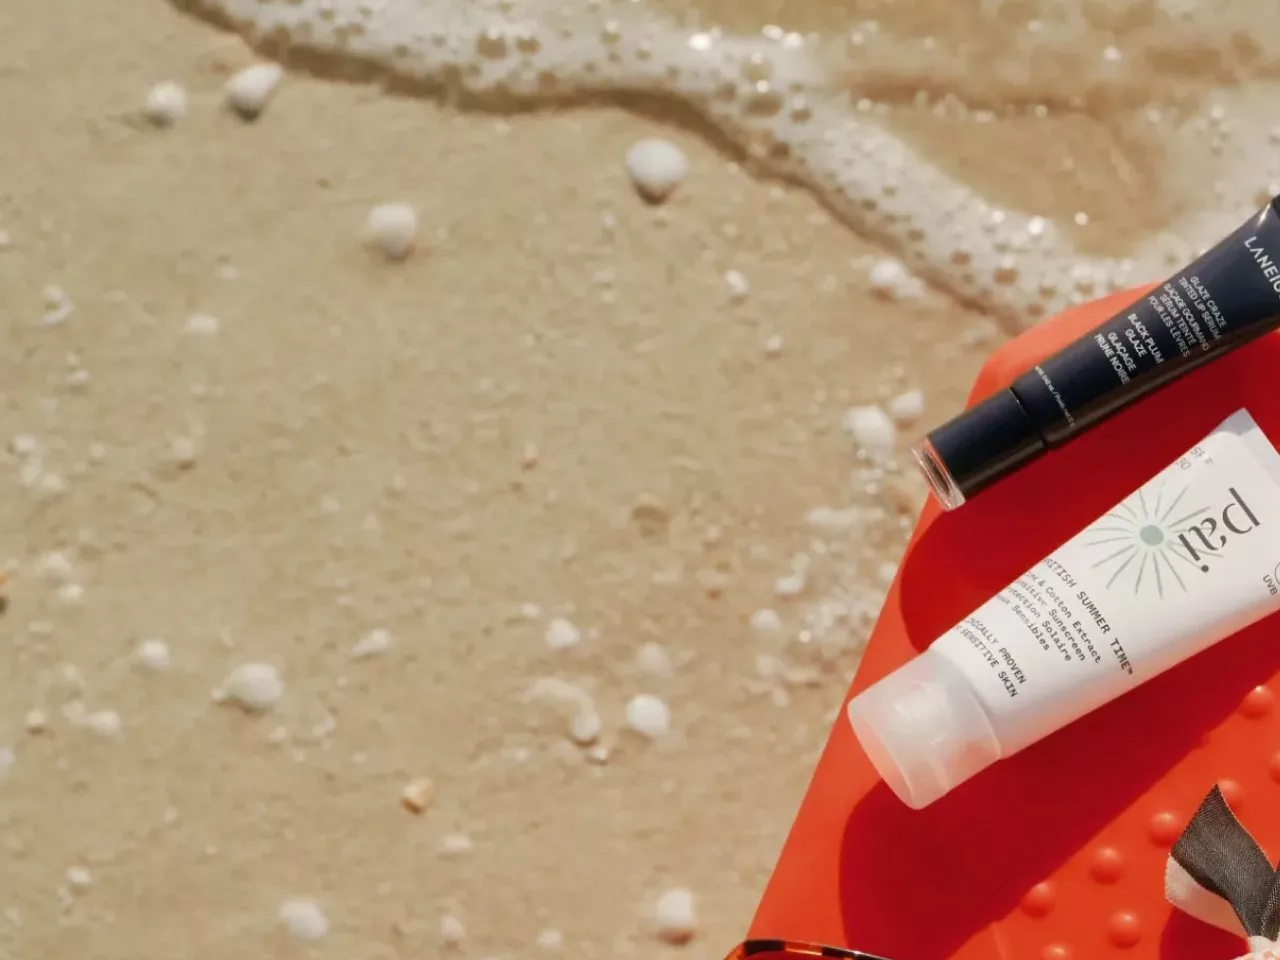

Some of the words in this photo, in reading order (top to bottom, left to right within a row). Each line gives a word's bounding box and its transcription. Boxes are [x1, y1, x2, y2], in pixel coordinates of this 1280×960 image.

[1148, 296, 1162, 313] POUR
[1160, 312, 1173, 327] LES
[1178, 277, 1198, 300] TINTED
[1194, 299, 1205, 312] LIP
[1190, 276, 1211, 300] GLAZE
[1207, 300, 1228, 328] CRAZE
[1094, 333, 1115, 358] PRUNE
[1110, 357, 1130, 385] NOIRE
[1108, 332, 1136, 372] GLAÇAGE
[1125, 329, 1147, 358] GLAZE
[1128, 313, 1149, 339] BLACK
[1145, 338, 1164, 365] PLUM
[1178, 487, 1261, 573] pai
[1263, 575, 1277, 595] UVB
[1012, 606, 1049, 651] Sensibles
[1046, 587, 1072, 618] Cotton
[1073, 621, 1101, 663] Extract
[1077, 591, 1110, 634] SUMMER
[1042, 621, 1071, 661] Solaire
[1049, 609, 1085, 661] Sunscreen
[998, 672, 1018, 698] SKIN
[999, 647, 1026, 684] PROVEN
